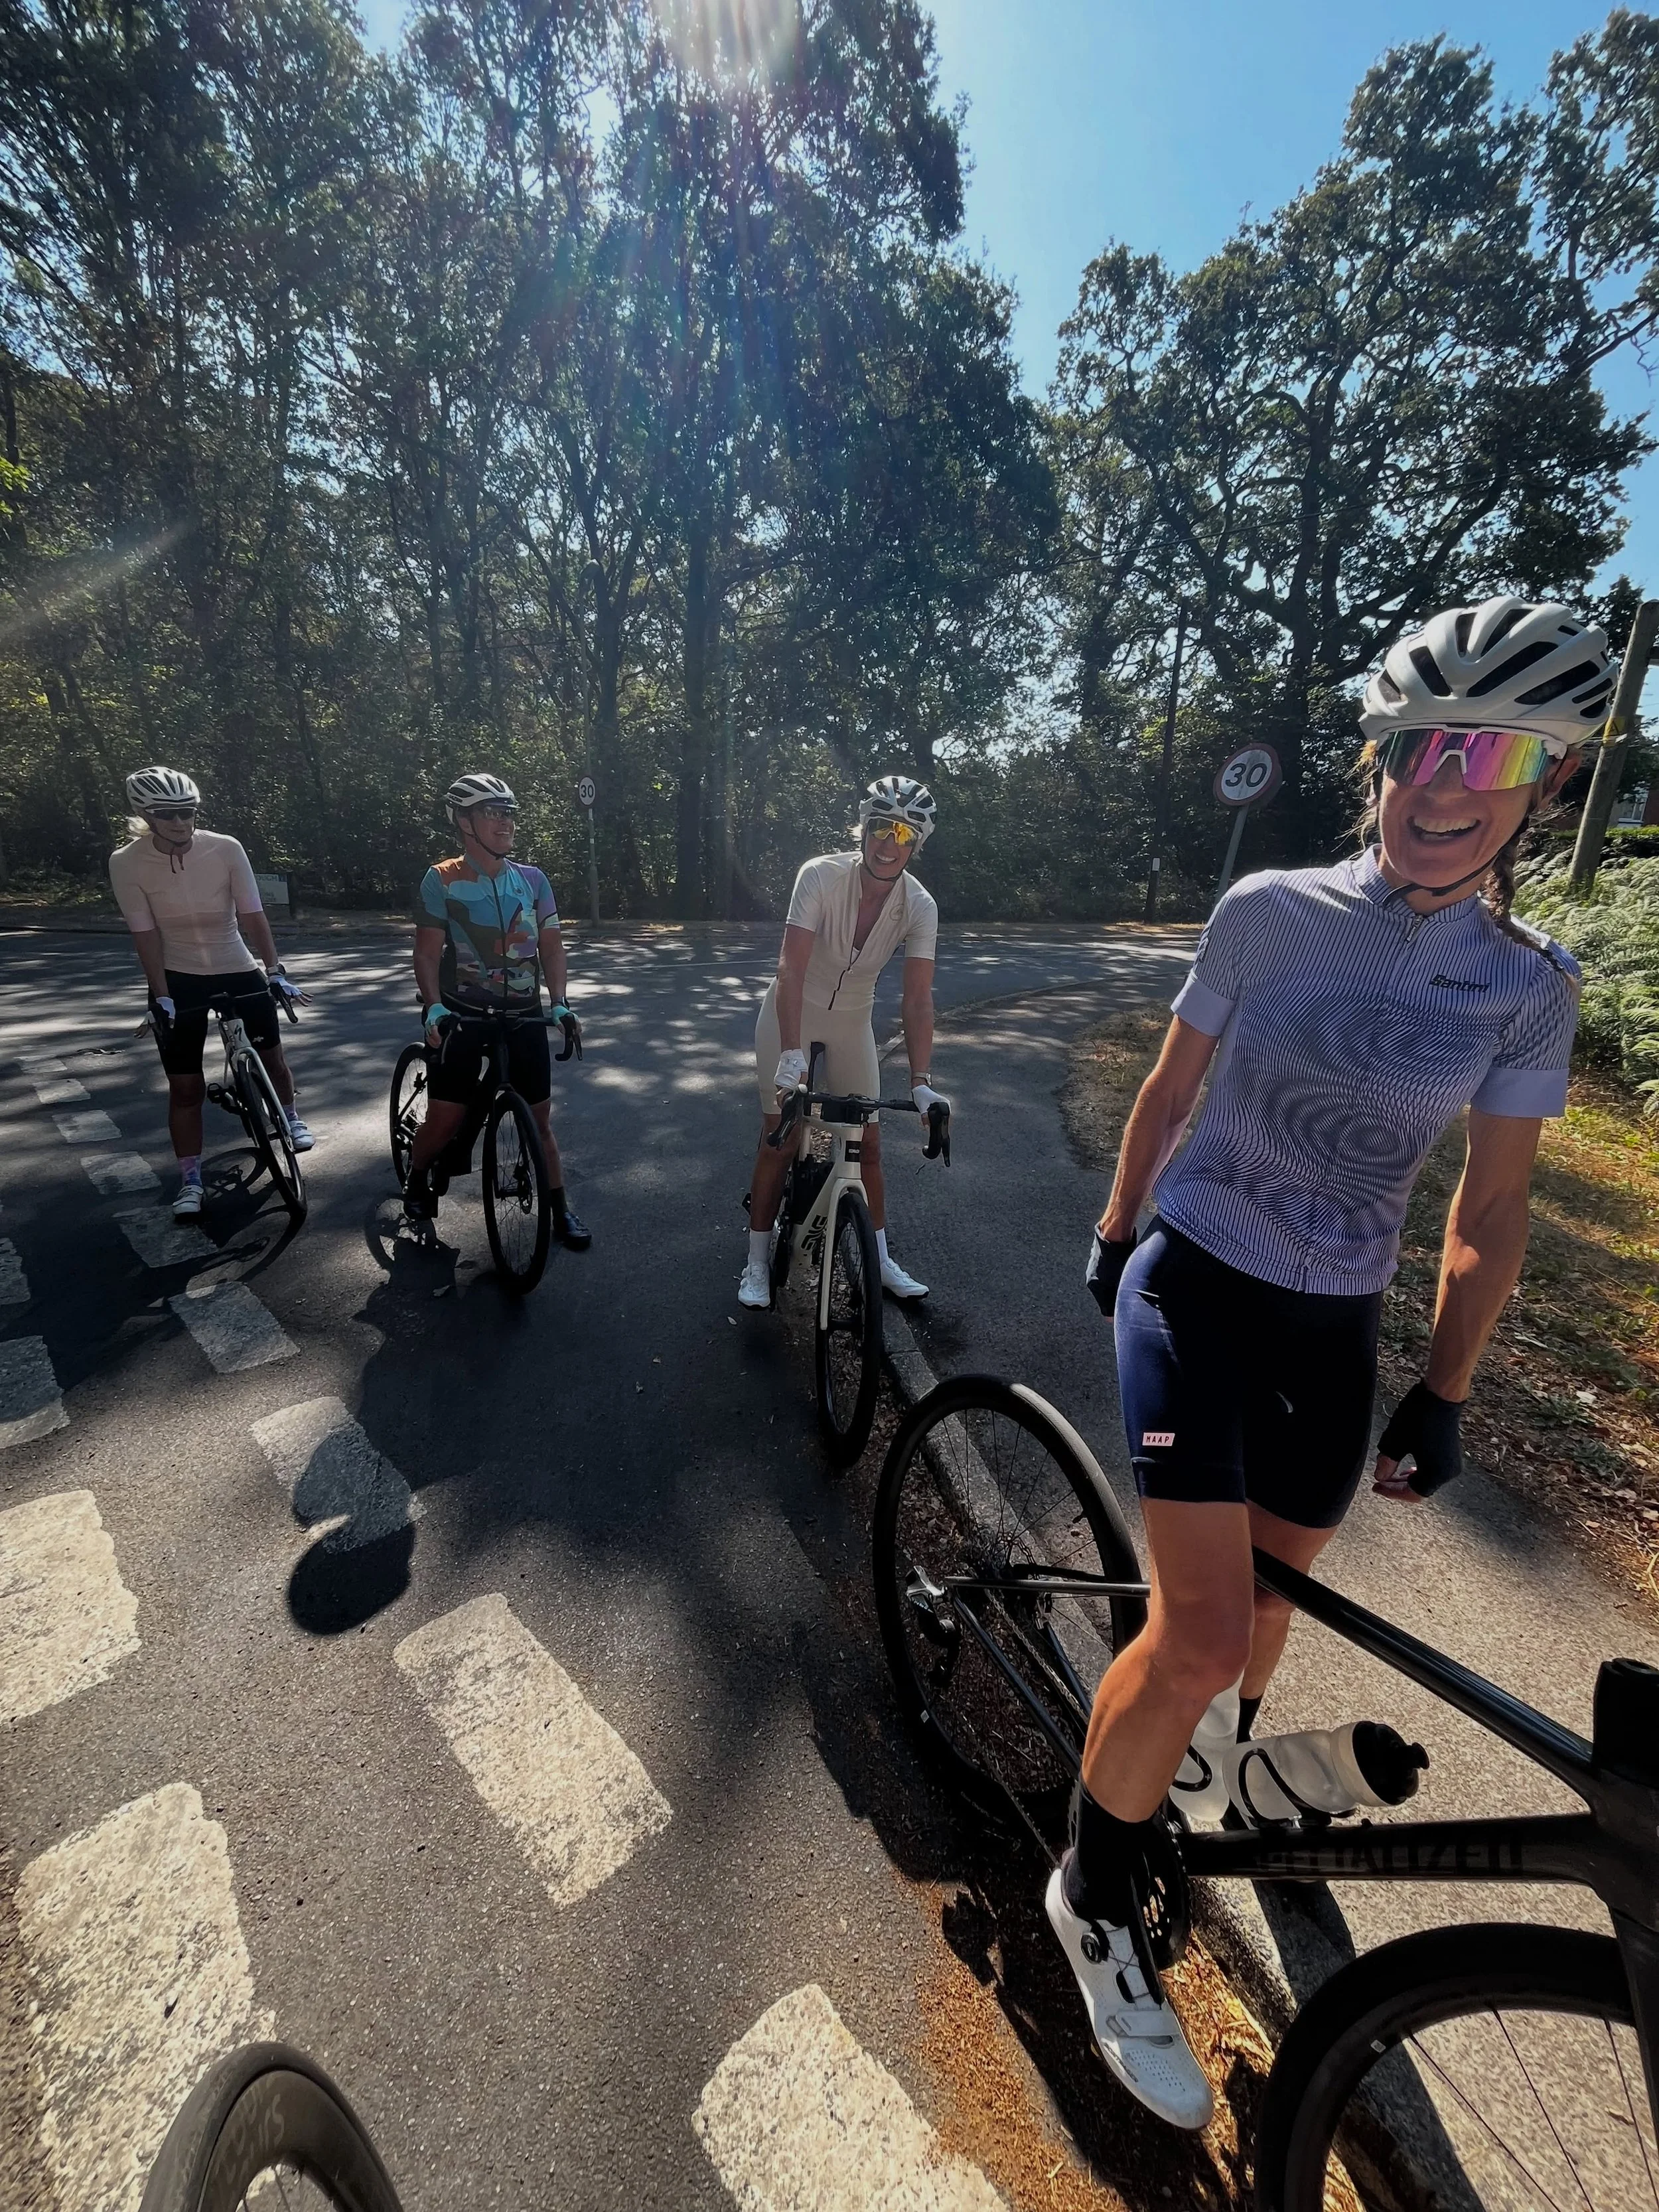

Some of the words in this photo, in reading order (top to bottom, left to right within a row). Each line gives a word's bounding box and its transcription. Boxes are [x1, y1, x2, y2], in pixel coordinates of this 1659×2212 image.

[1225, 763, 1267, 787] 30
[581, 784, 594, 798] 30
[1429, 974, 1491, 993] Santini
